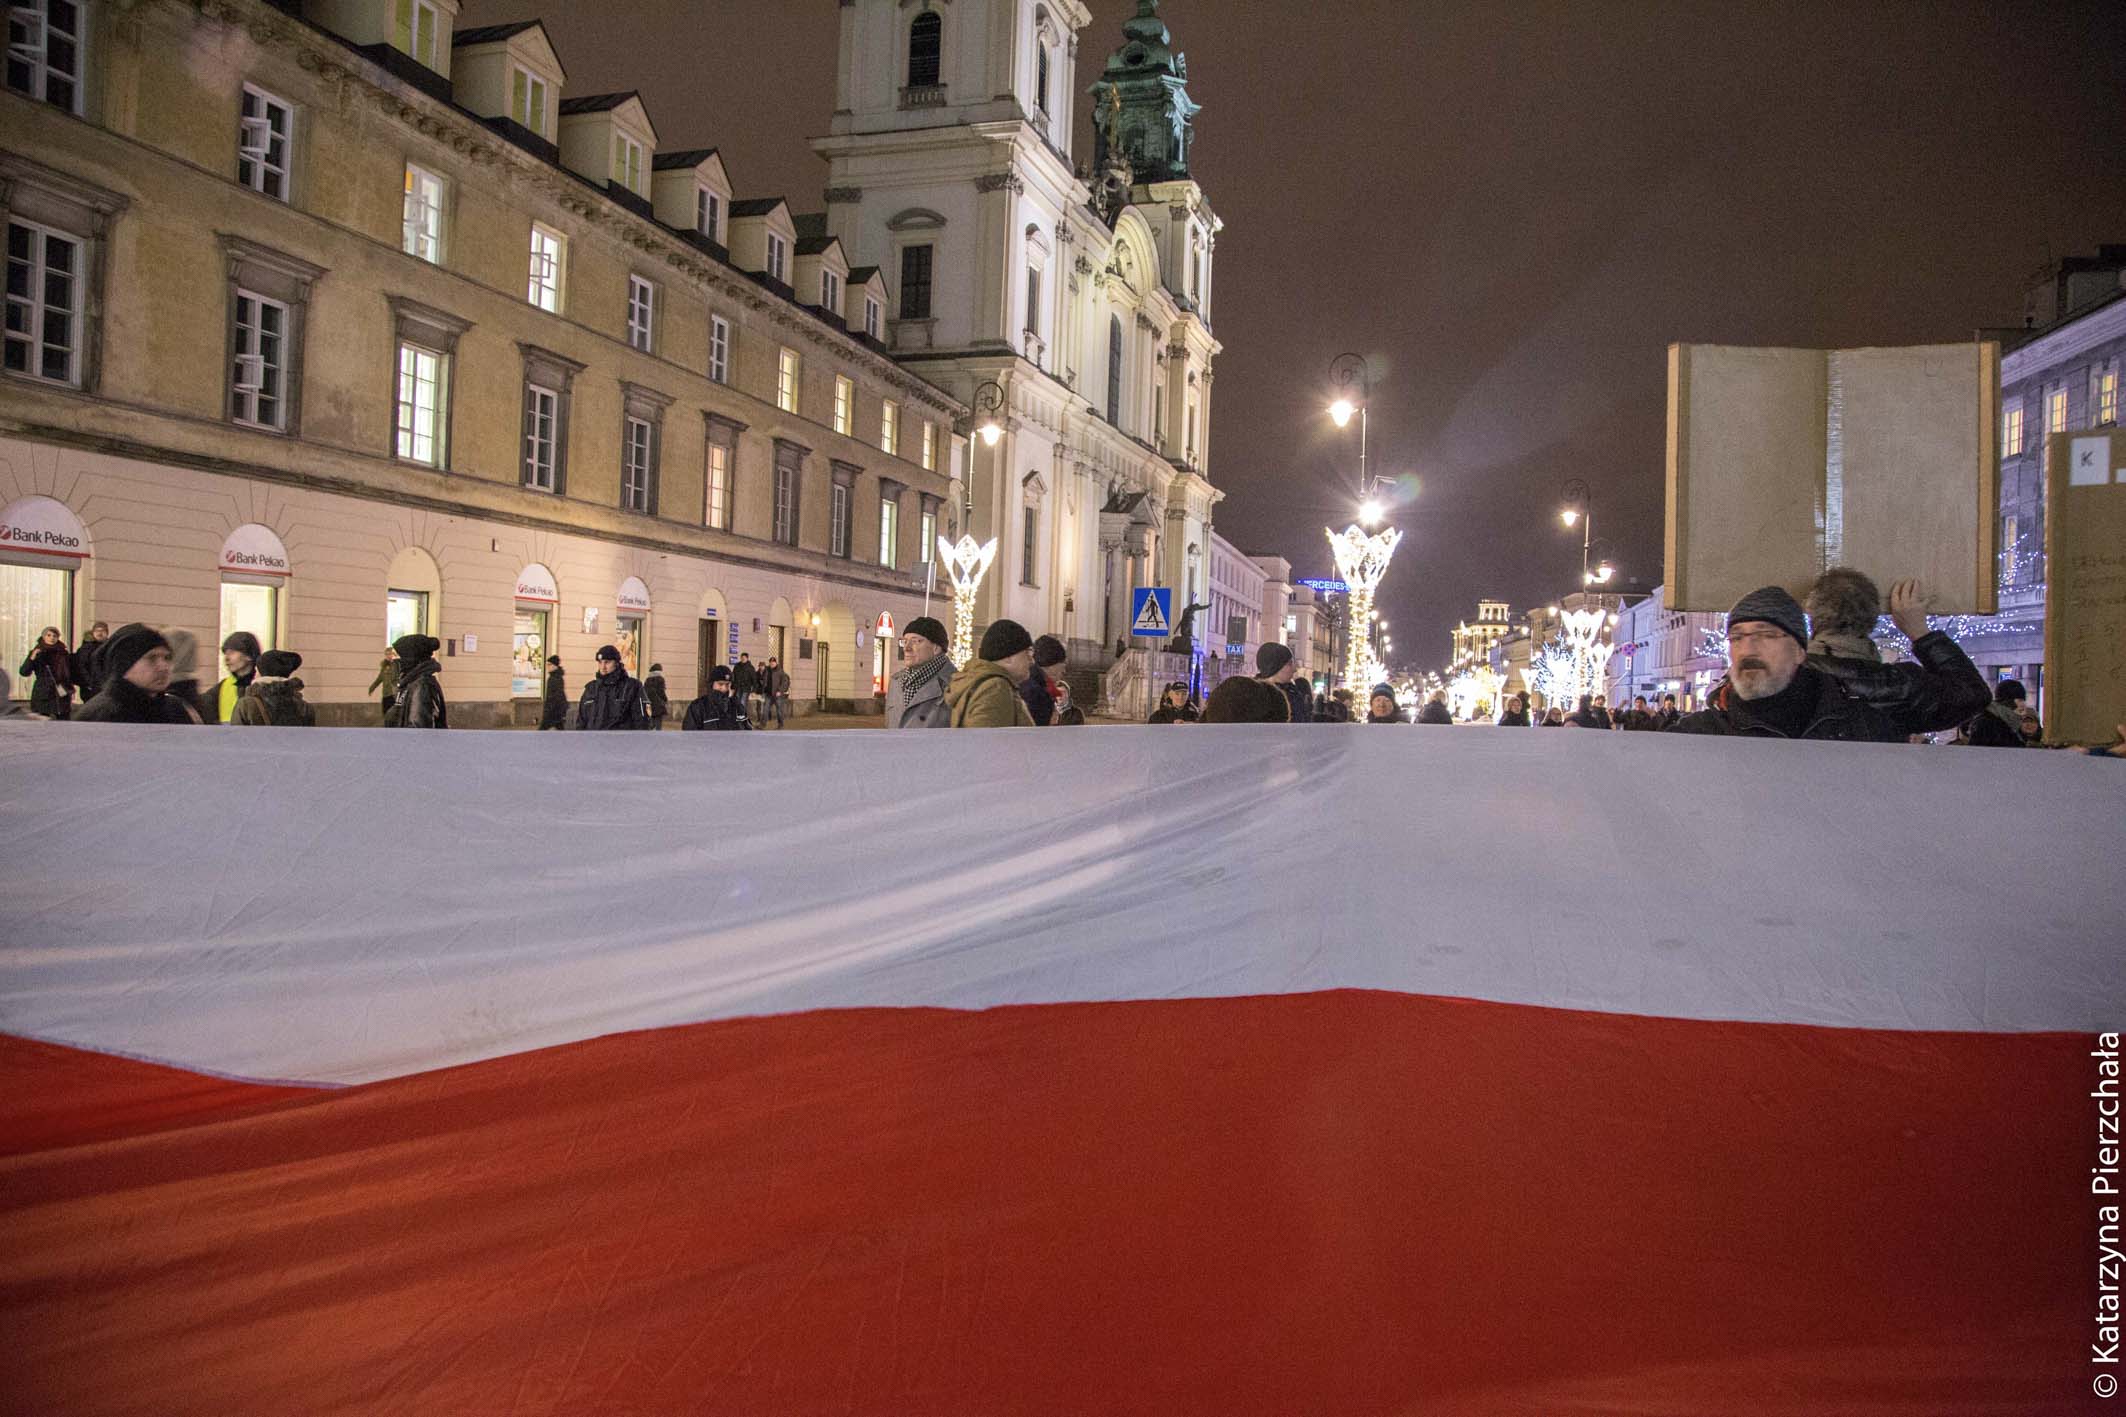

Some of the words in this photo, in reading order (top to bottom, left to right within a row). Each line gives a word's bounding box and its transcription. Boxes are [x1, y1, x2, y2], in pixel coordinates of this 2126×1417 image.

[13, 527, 42, 543] Bank
[44, 531, 80, 548] Pekao
[236, 551, 258, 565] Bank
[259, 554, 285, 568] Pekao
[1227, 645, 1244, 655] TAXI
